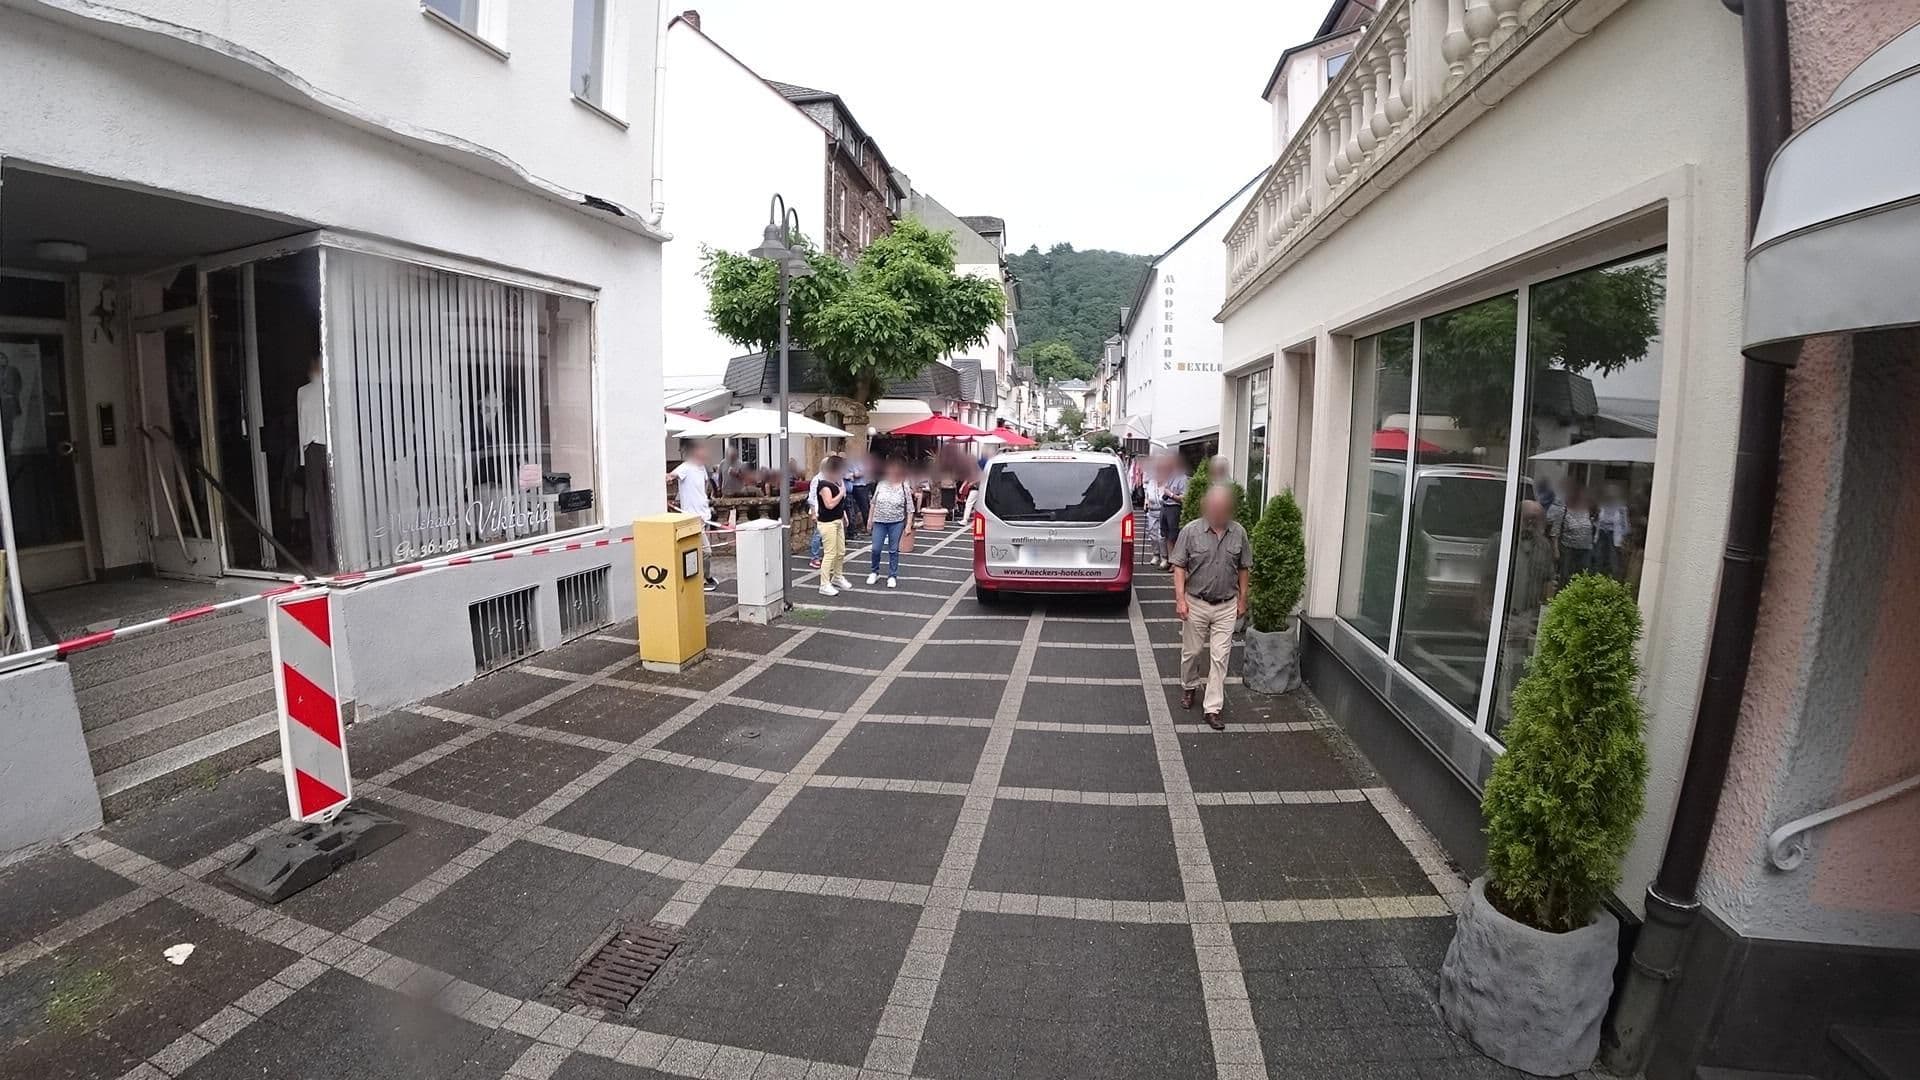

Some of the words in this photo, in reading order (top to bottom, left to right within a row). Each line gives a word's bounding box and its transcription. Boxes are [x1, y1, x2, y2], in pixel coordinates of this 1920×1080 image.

[1163, 274, 1175, 371] MODEHAUS
[465, 497, 551, 534] Viktoria
[1003, 568, 1102, 577] www.haeckers-hotels.com
